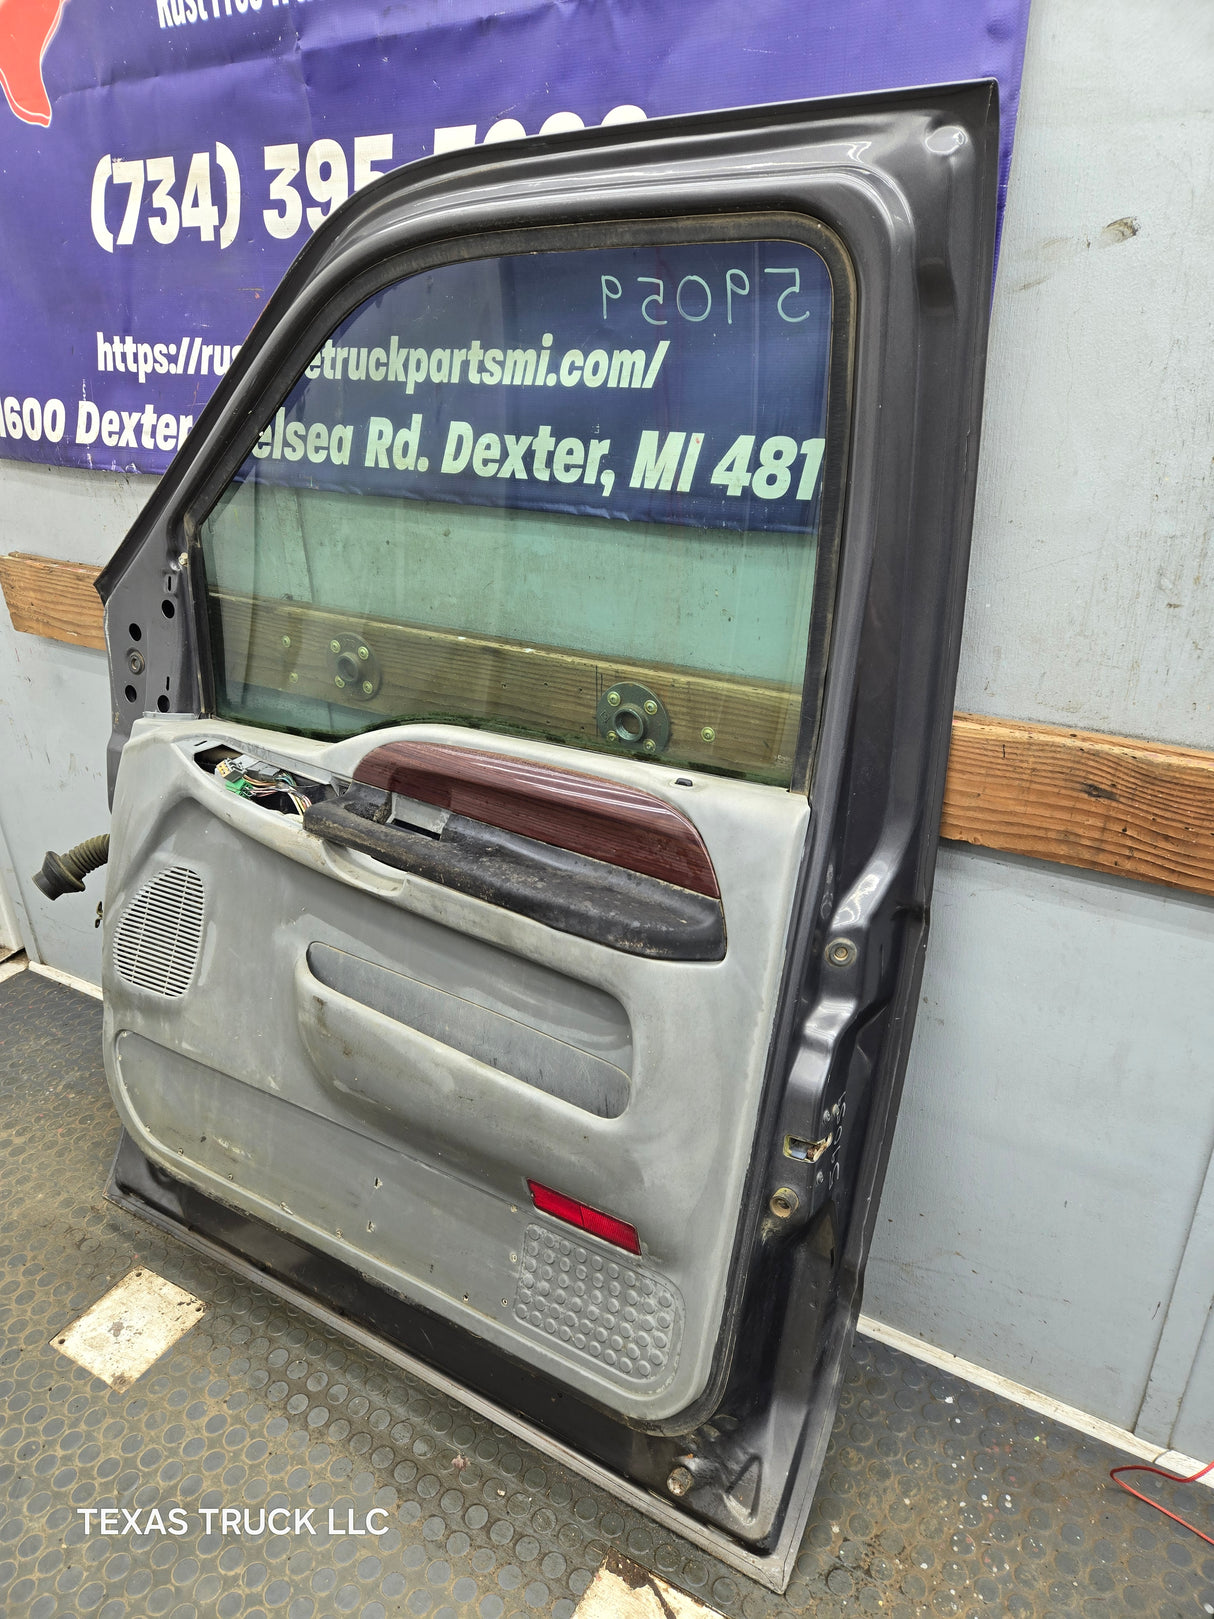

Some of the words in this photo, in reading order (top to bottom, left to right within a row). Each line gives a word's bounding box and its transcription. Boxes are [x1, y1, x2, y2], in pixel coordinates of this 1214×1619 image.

[90, 141, 241, 253] (734)
[75, 400, 195, 452] Dexter
[251, 406, 354, 466] elsea
[365, 413, 430, 472] Rd.
[440, 420, 616, 497] Dexter,
[629, 429, 705, 493] MI
